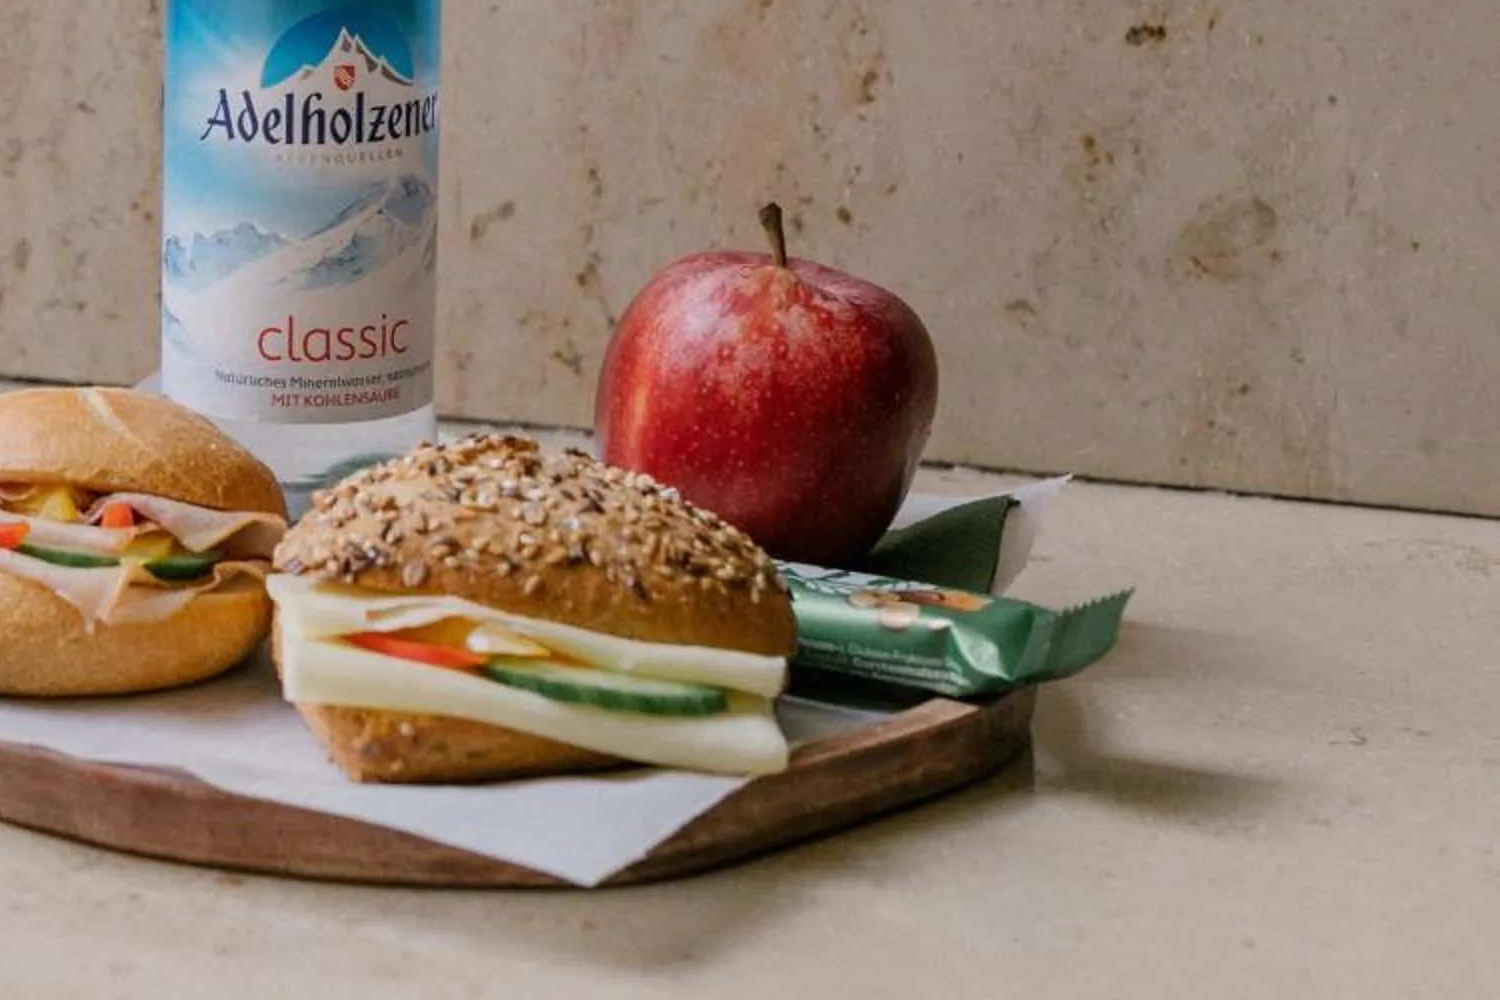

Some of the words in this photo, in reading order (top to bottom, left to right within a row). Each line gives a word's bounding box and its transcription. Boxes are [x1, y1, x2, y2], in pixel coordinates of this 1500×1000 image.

[200, 88, 439, 146] Adelholzener
[257, 313, 410, 363] classic
[271, 393, 300, 408] MIT
